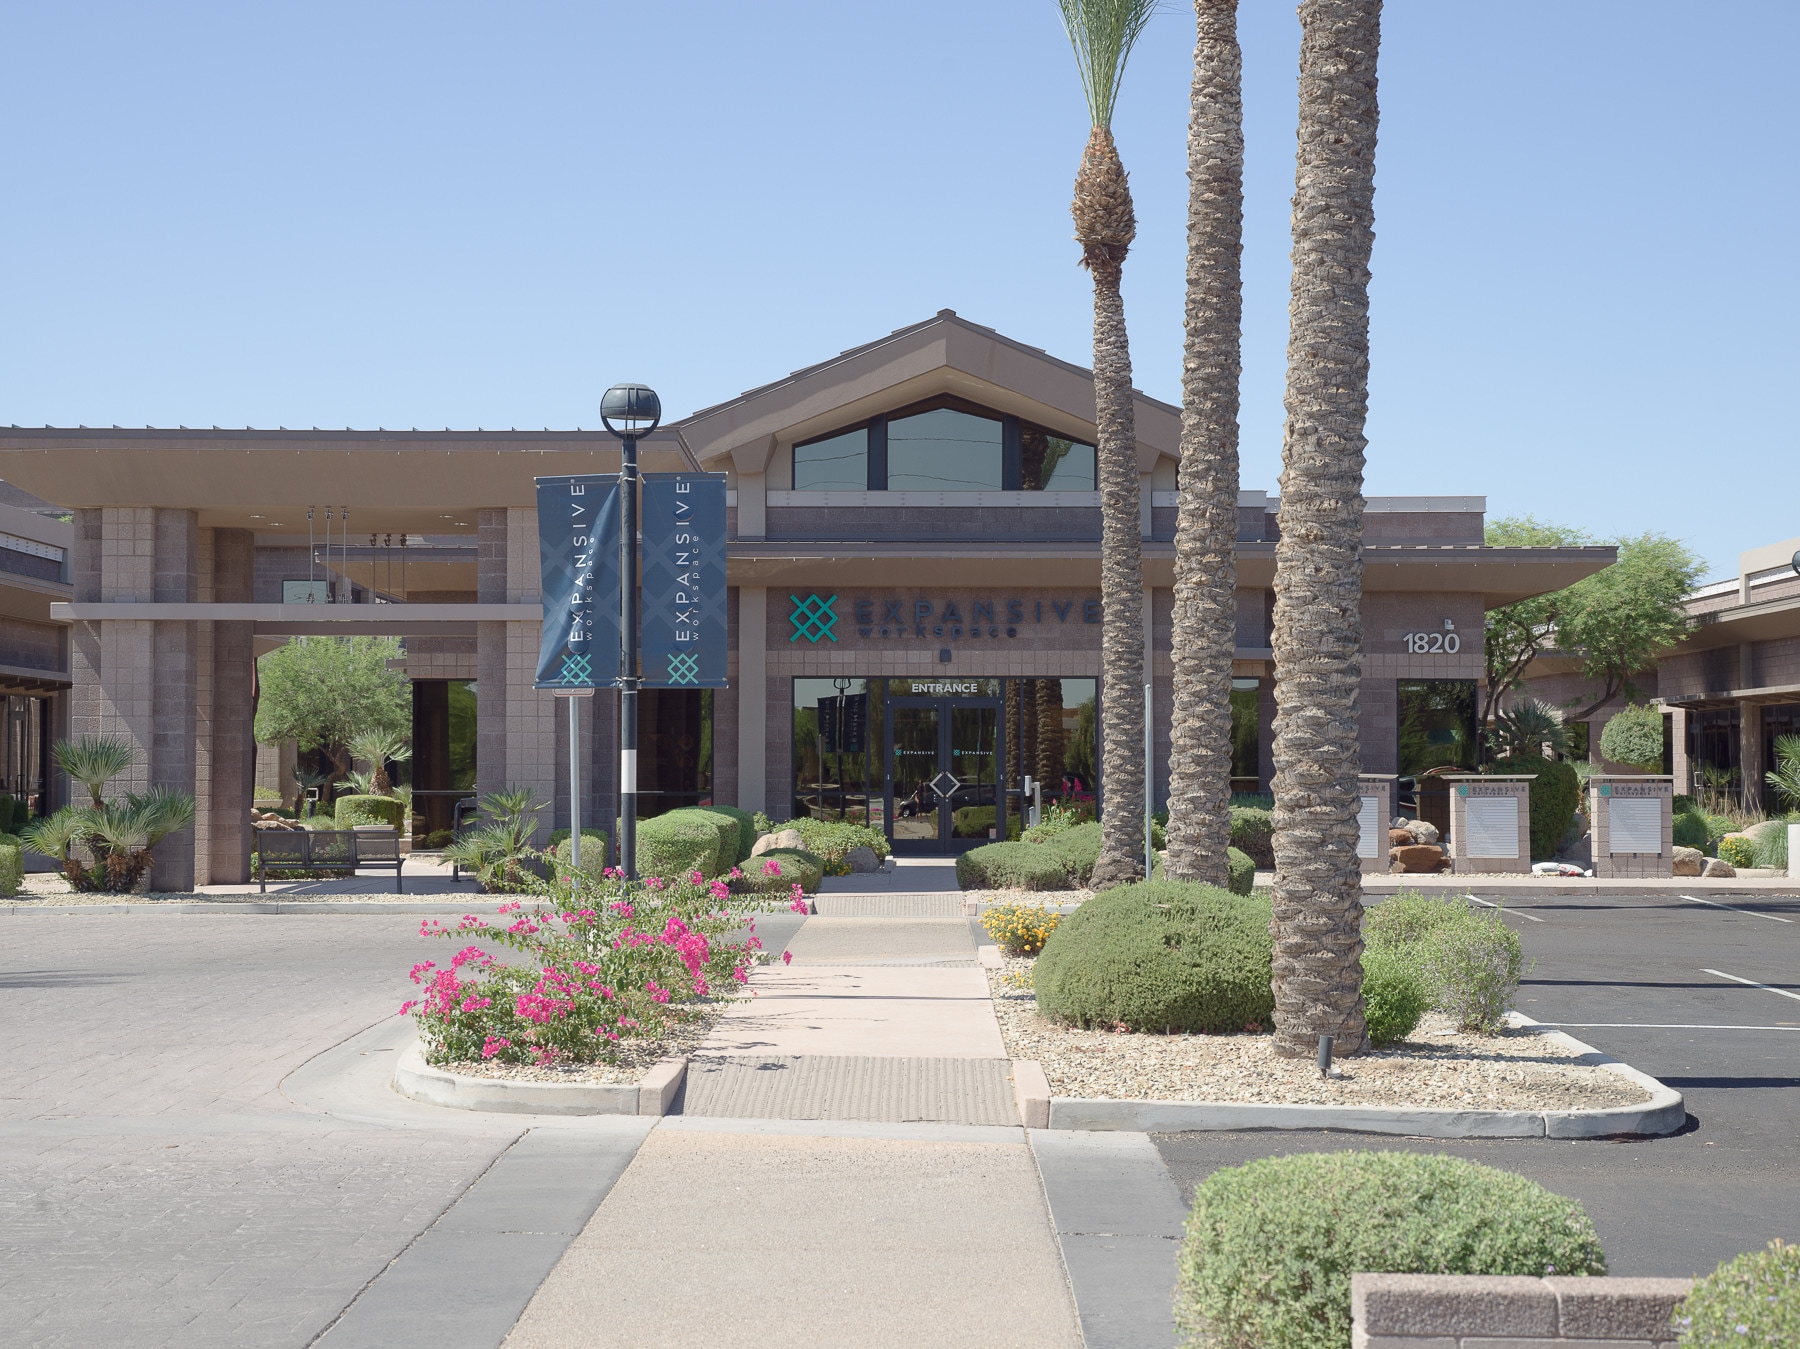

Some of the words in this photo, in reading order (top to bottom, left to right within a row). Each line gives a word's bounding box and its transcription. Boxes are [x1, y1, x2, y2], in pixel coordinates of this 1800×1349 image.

[570, 484, 588, 642] EXPANSIVE
[675, 482, 690, 641] EXPANSIVE
[692, 535, 700, 641] workspace
[856, 600, 1101, 624] EXPANSIVE
[858, 624, 1018, 640] workspace
[1403, 632, 1460, 653] 1820
[911, 683, 978, 693] ENTRANCE
